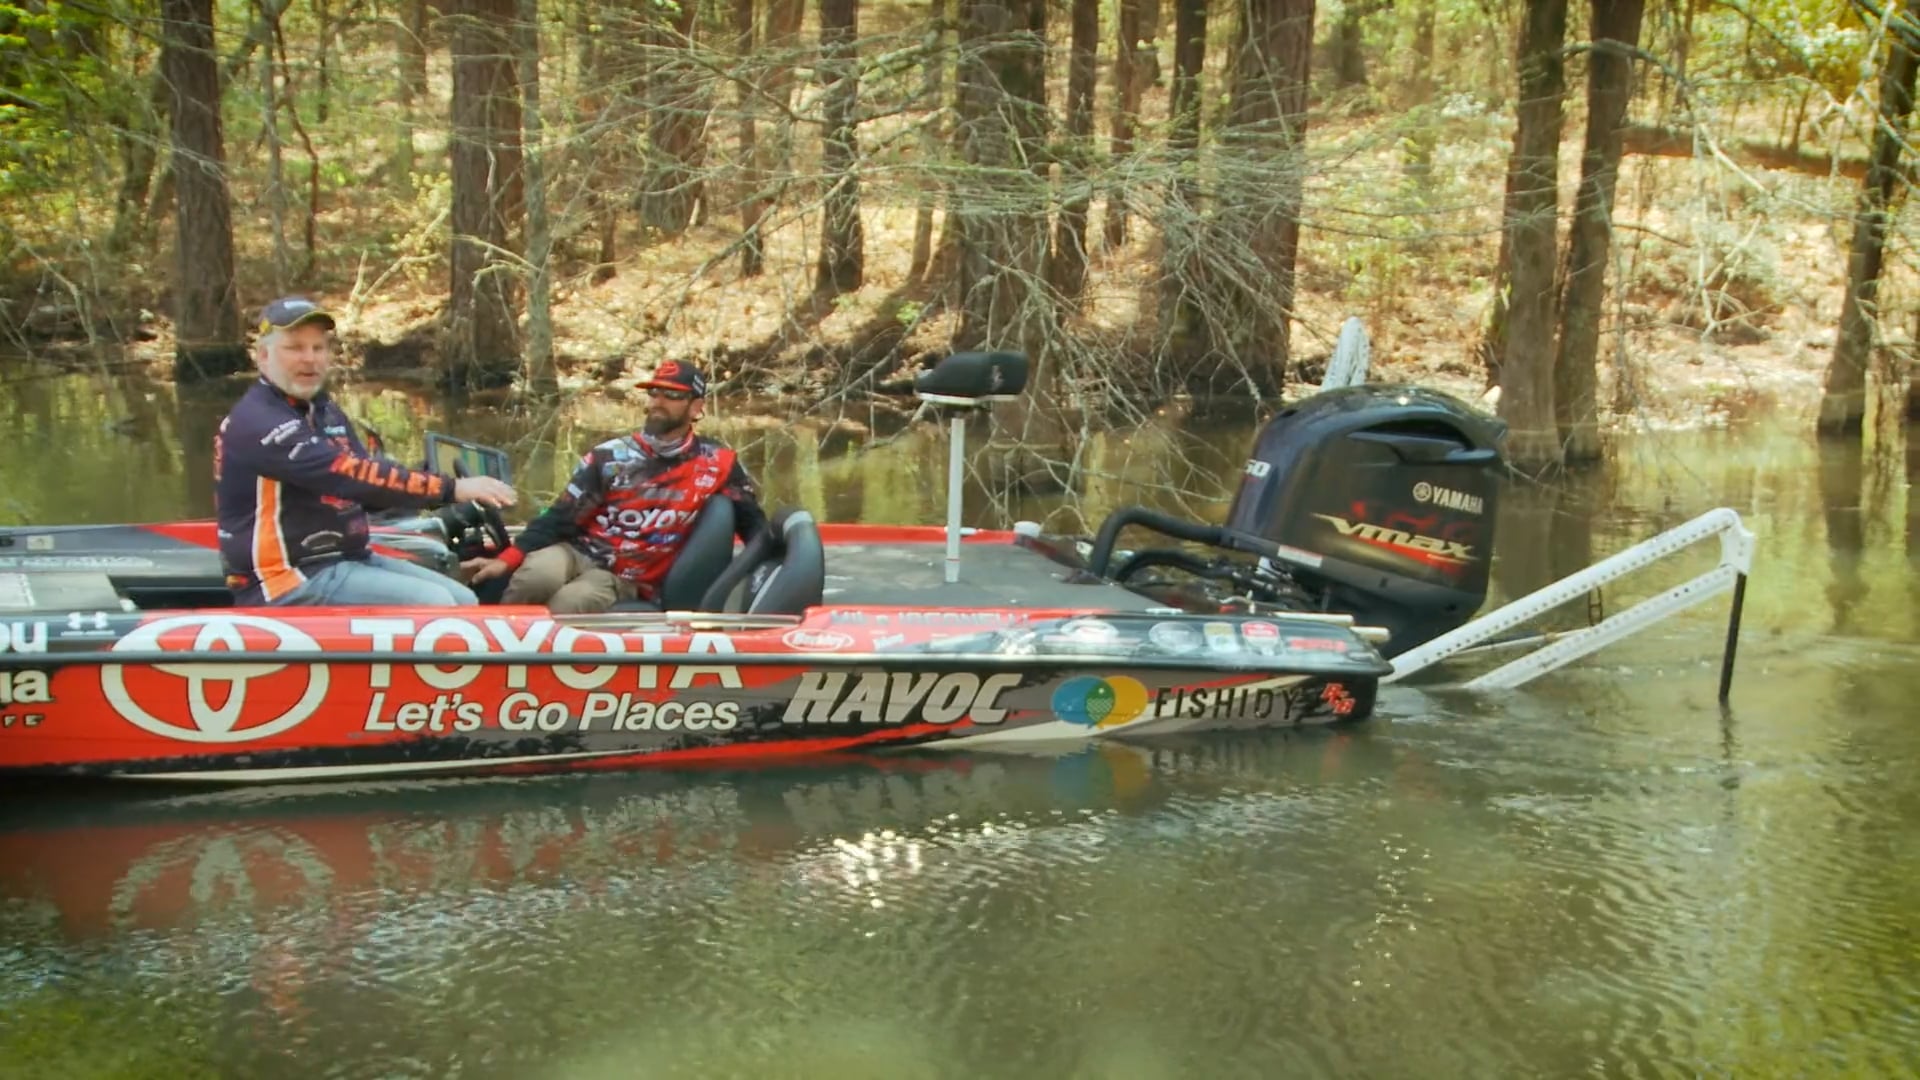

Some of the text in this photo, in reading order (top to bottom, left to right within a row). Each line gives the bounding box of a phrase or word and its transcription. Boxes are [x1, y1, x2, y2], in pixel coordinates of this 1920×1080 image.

[1433, 486, 1484, 515] YAMAHA
[350, 617, 744, 690] TOYOTA
[363, 689, 740, 732] Let's Go Places
[782, 671, 1024, 725] HAVOC
[1154, 687, 1299, 720] FISHIDY
